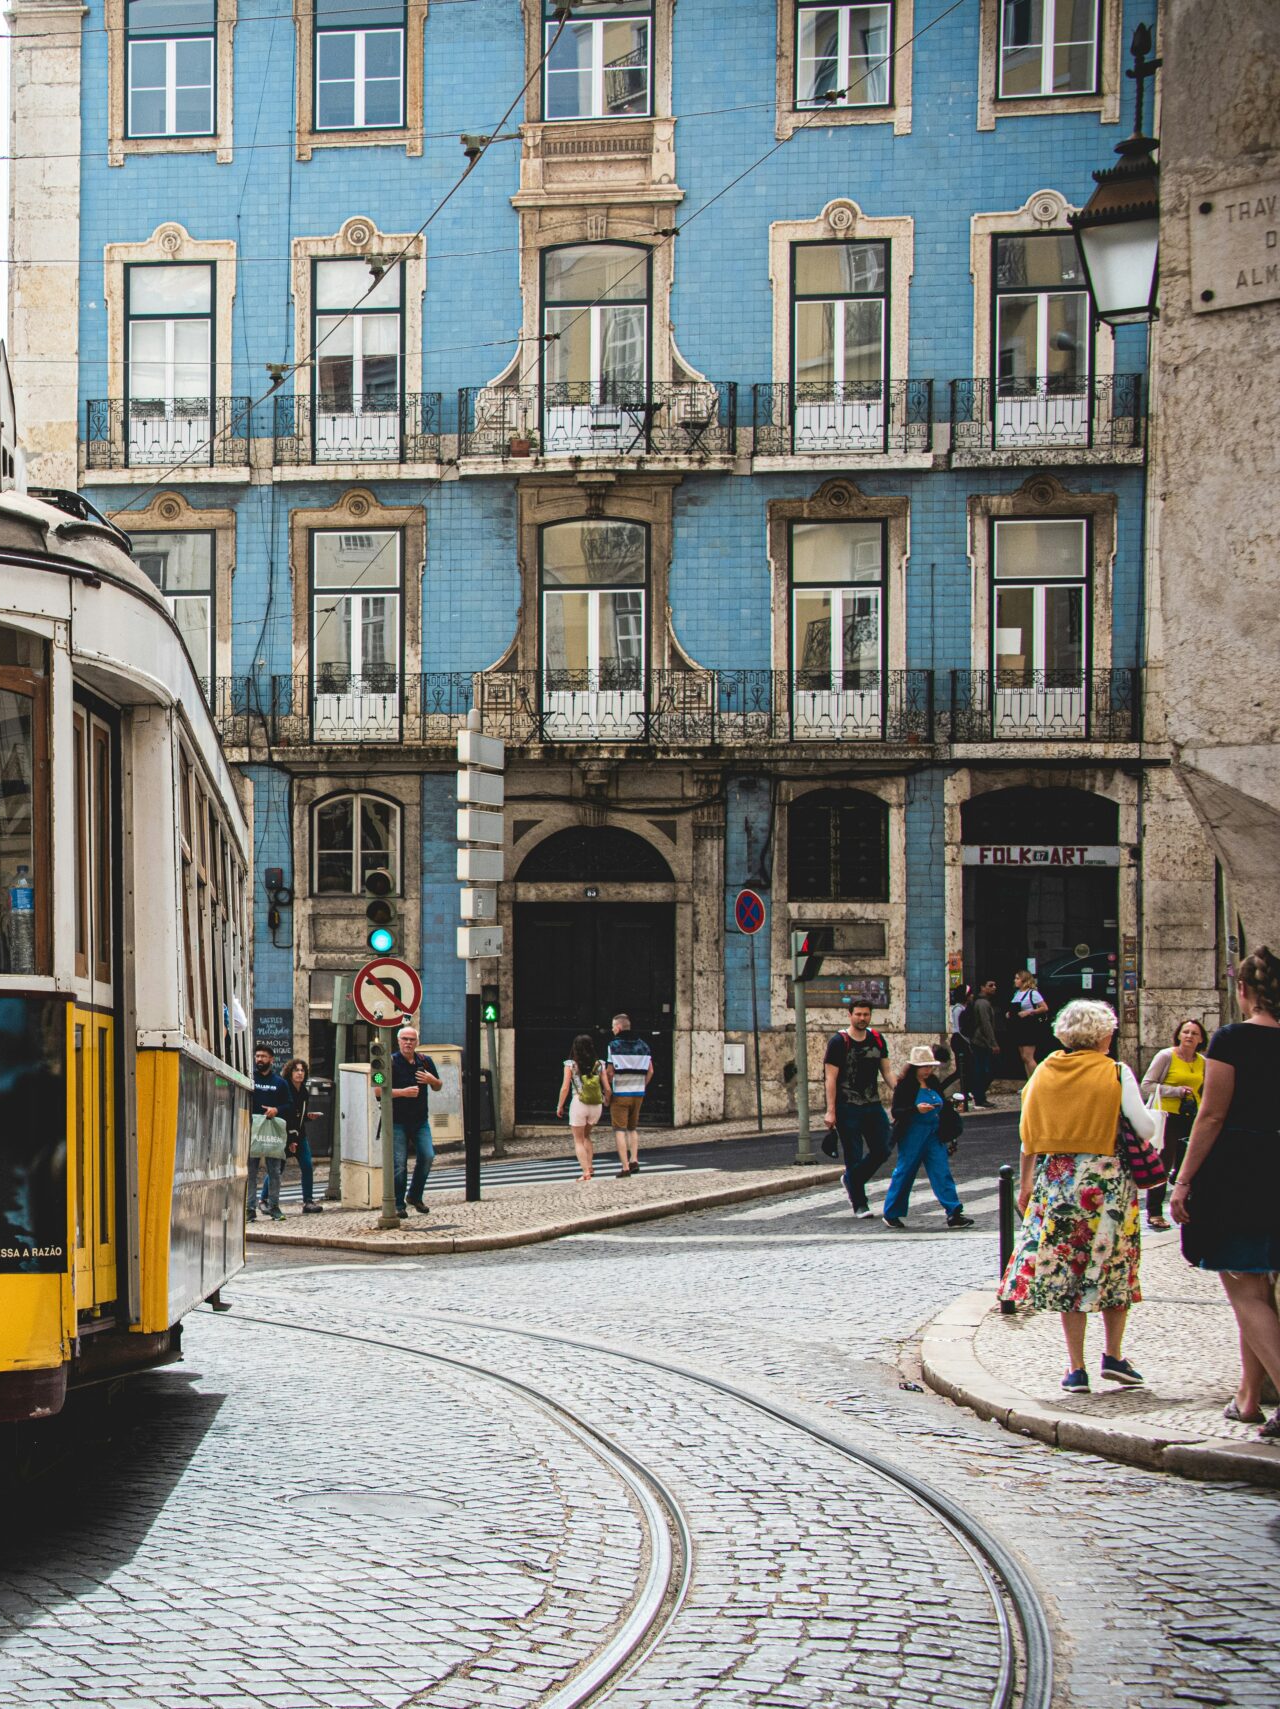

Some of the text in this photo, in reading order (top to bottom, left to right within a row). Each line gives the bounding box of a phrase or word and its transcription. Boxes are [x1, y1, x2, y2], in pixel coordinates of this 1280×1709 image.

[1224, 195, 1277, 223] TRAV
[1235, 264, 1278, 289] ALM
[979, 847, 1088, 864] FOLK ART
[22, 1248, 30, 1257] A
[31, 1244, 63, 1257] RAZÃO
